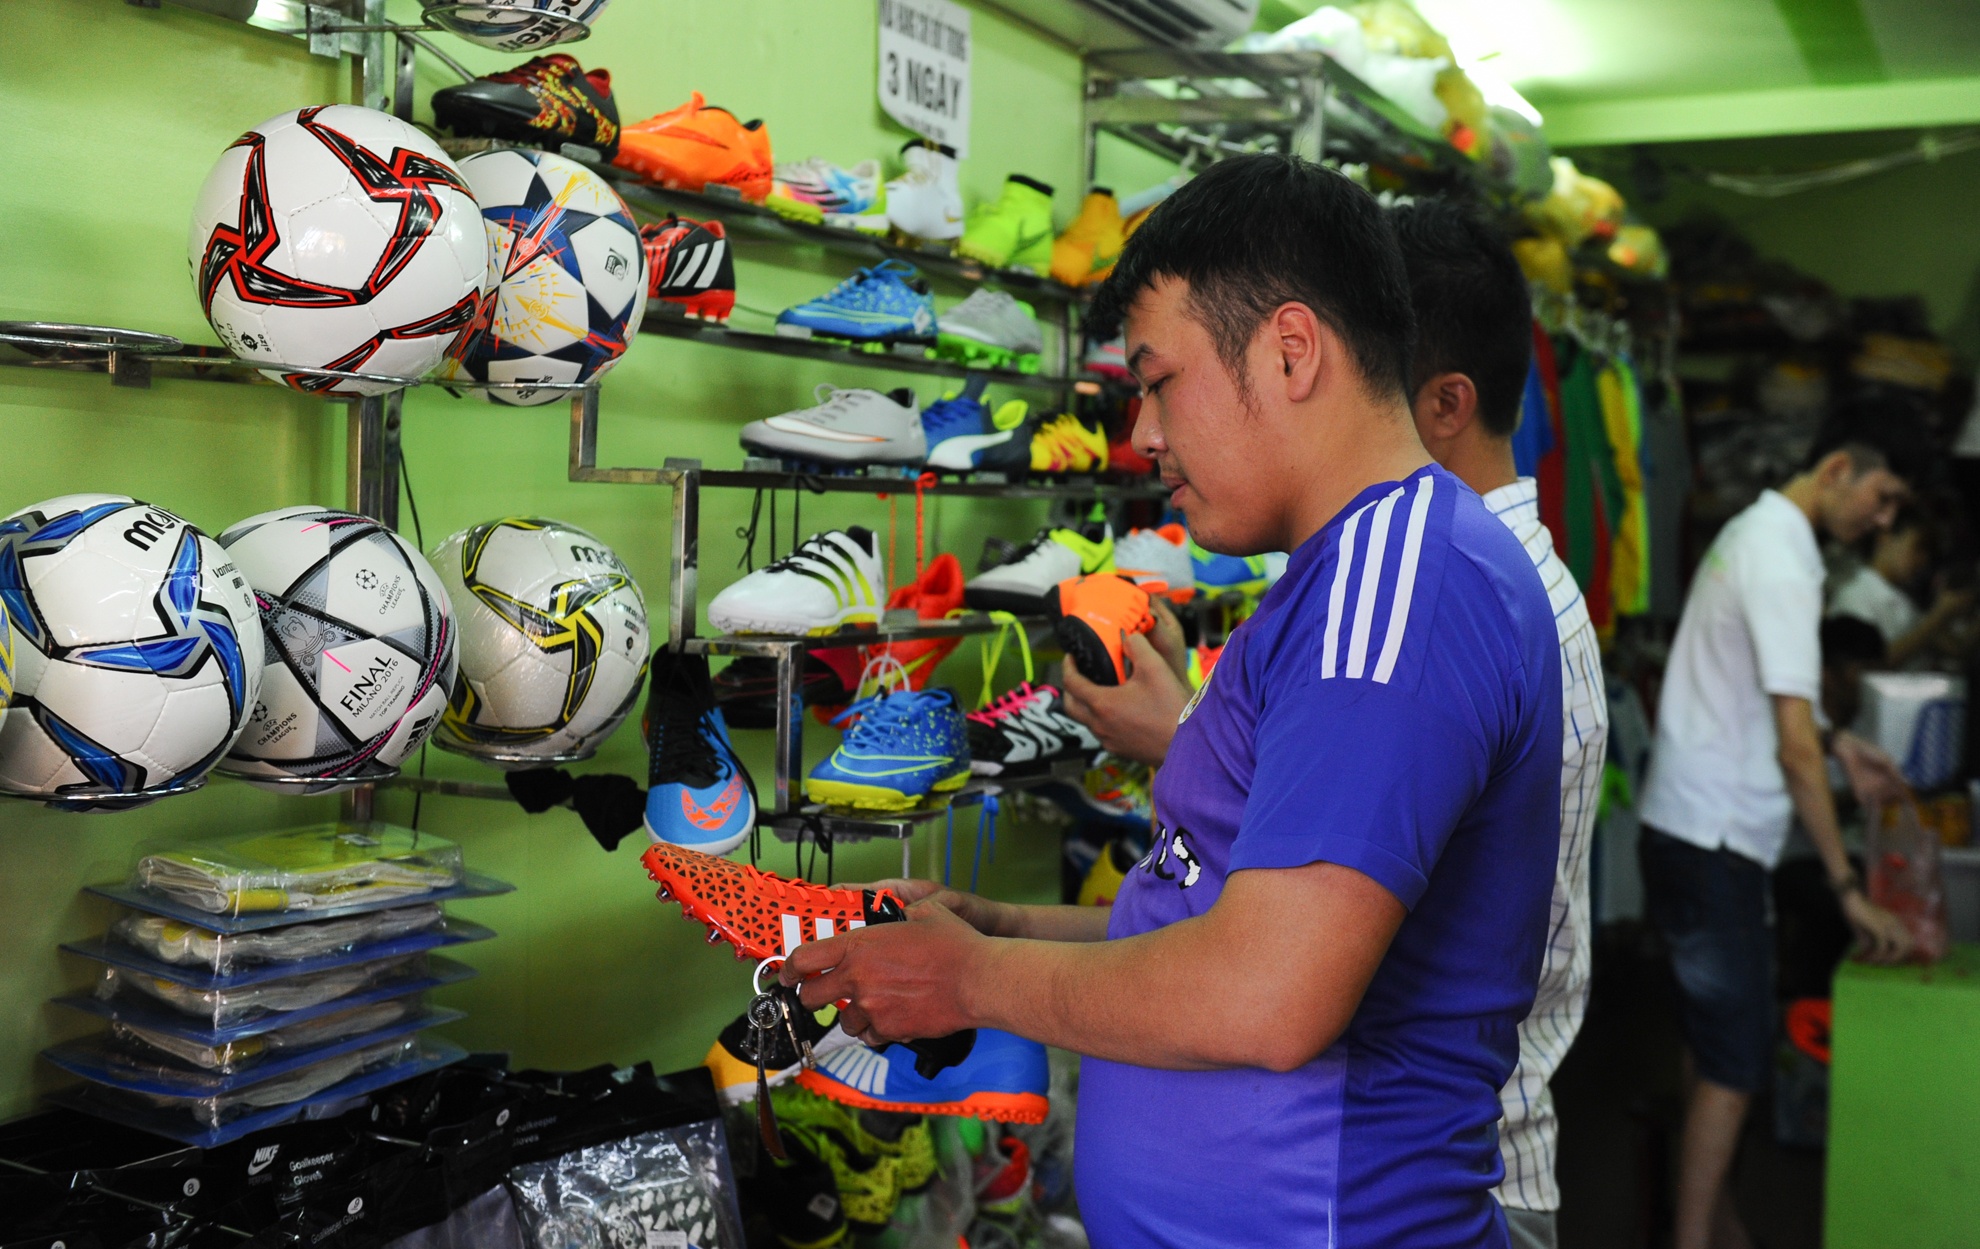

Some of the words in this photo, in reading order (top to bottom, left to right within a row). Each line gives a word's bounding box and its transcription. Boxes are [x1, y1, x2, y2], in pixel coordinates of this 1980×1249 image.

[887, 52, 899, 96] 3
[257, 333, 272, 353] size
[378, 574, 402, 615] CHAMPIONS
[340, 656, 392, 711] FINAL
[352, 683, 383, 718] MILANO
[381, 659, 399, 683] 2016
[257, 712, 298, 746] CHAMPIONS
[513, 1115, 557, 1134] oalkeeper
[253, 1143, 280, 1164] NIKE
[289, 1152, 334, 1172] Goalkeeper
[293, 1169, 323, 1186] Gloves
[187, 1183, 195, 1194] 8
